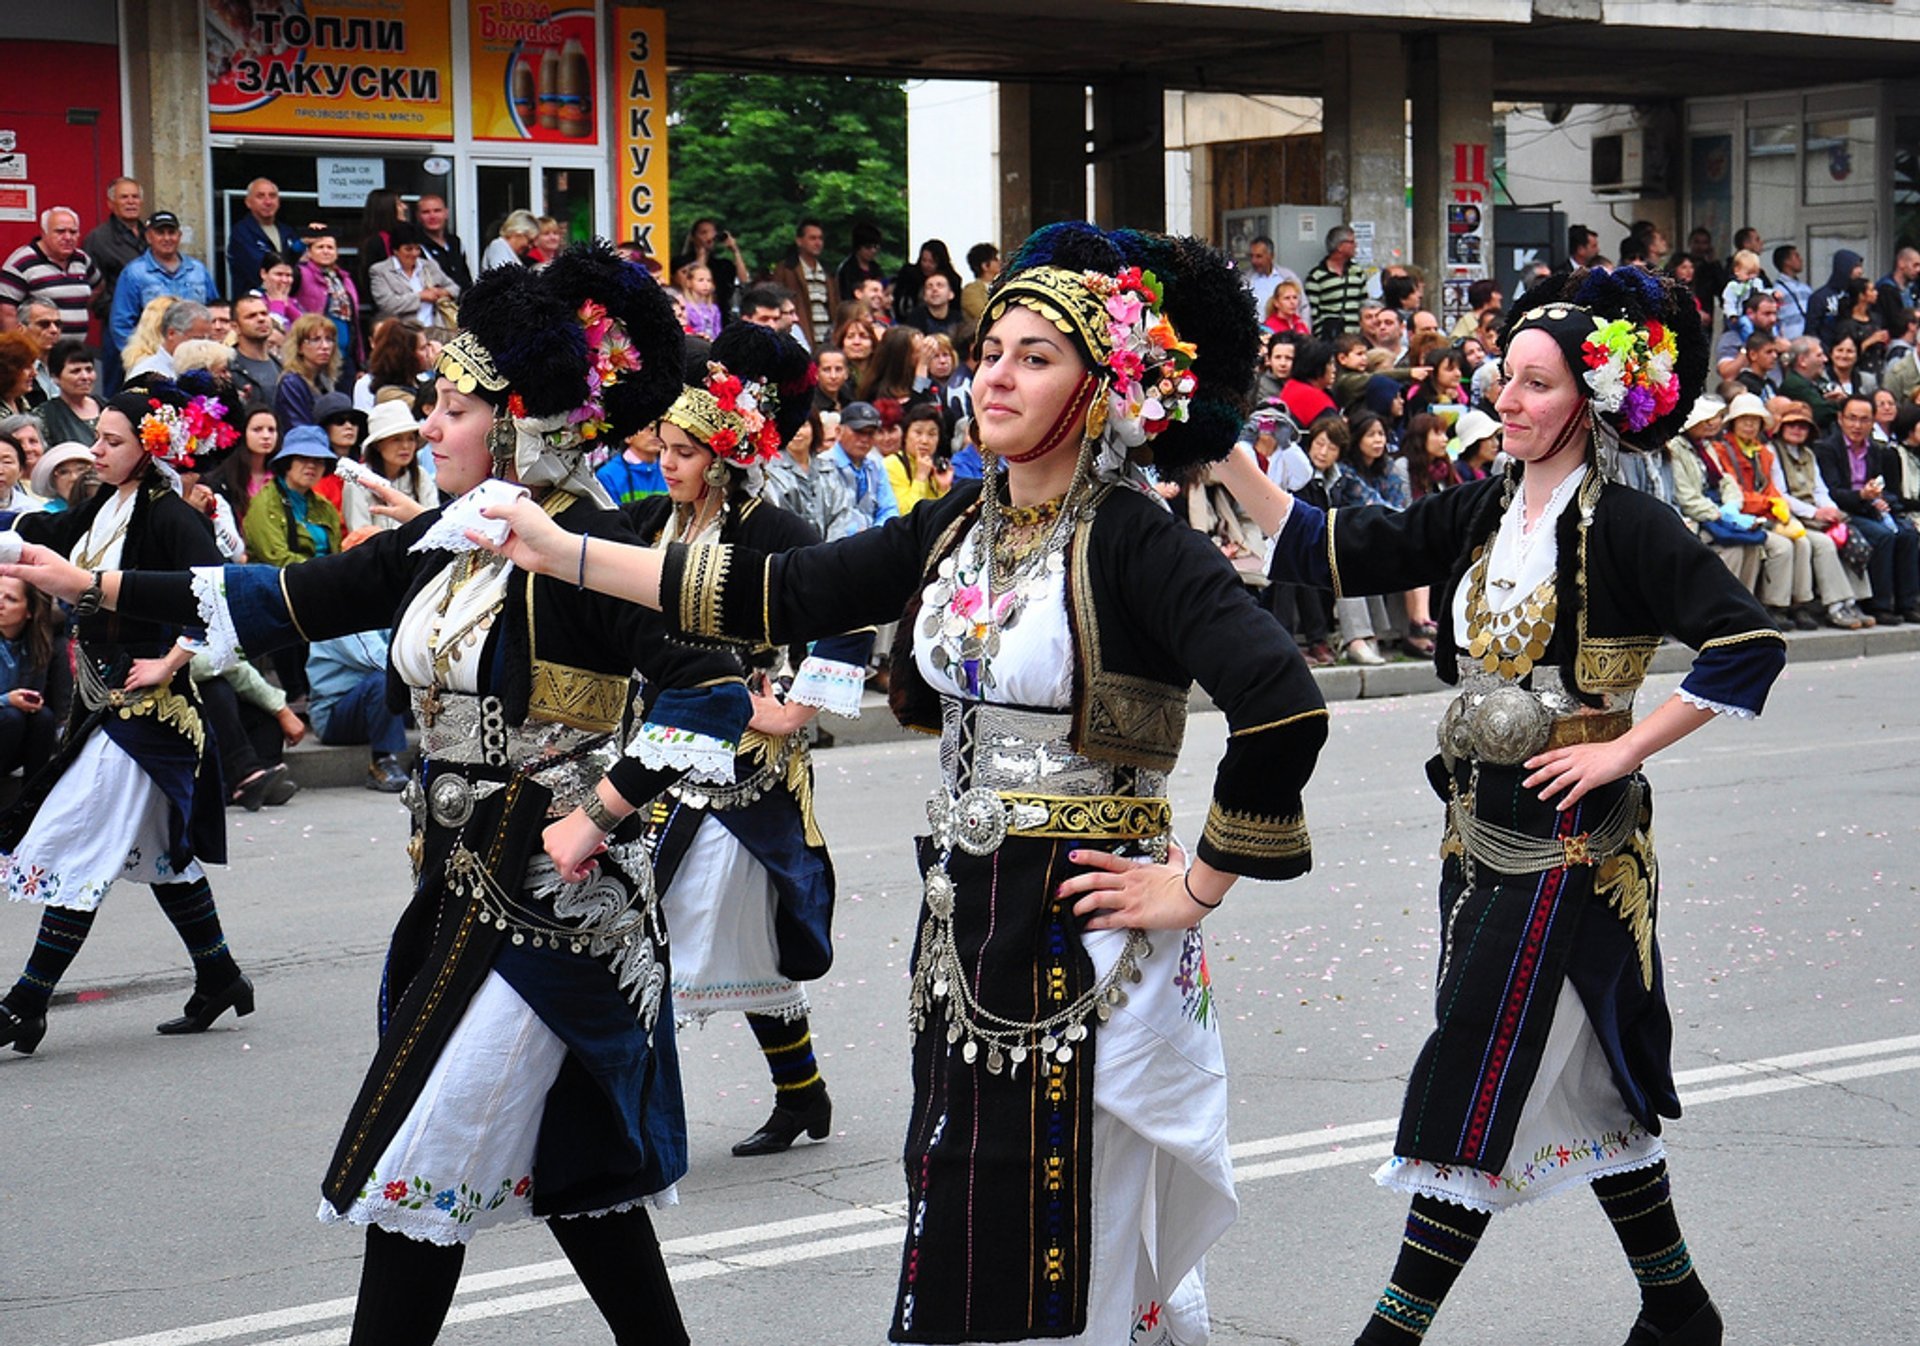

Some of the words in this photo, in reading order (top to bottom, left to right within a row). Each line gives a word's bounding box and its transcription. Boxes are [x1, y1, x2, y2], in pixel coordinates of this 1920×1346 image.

[255, 13, 404, 51] ТОПЛИ
[236, 61, 438, 99] ЗАКУСКИ
[389, 112, 425, 123] МЯСТО
